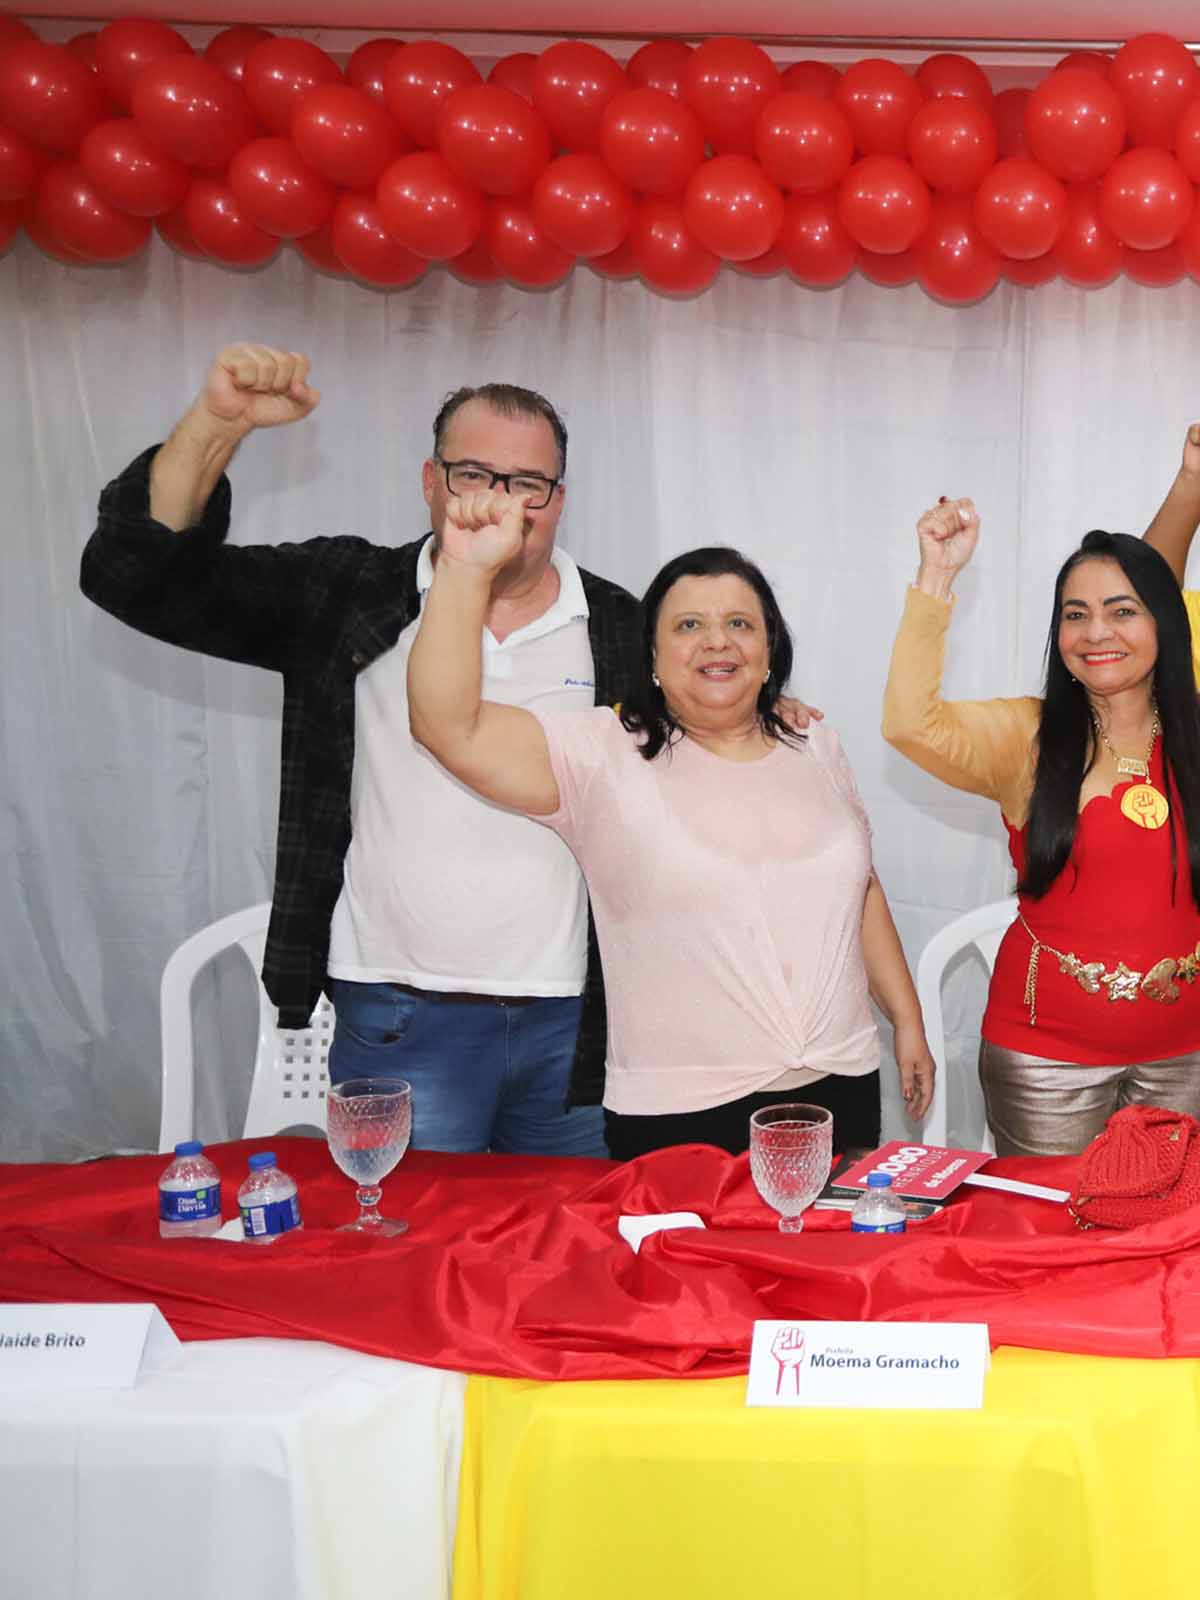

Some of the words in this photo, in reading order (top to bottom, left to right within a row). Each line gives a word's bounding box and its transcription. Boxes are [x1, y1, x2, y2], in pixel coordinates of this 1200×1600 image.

[45, 1332, 86, 1347] Brito
[810, 1353, 871, 1368] Moema
[875, 1354, 960, 1369] Gramacho
